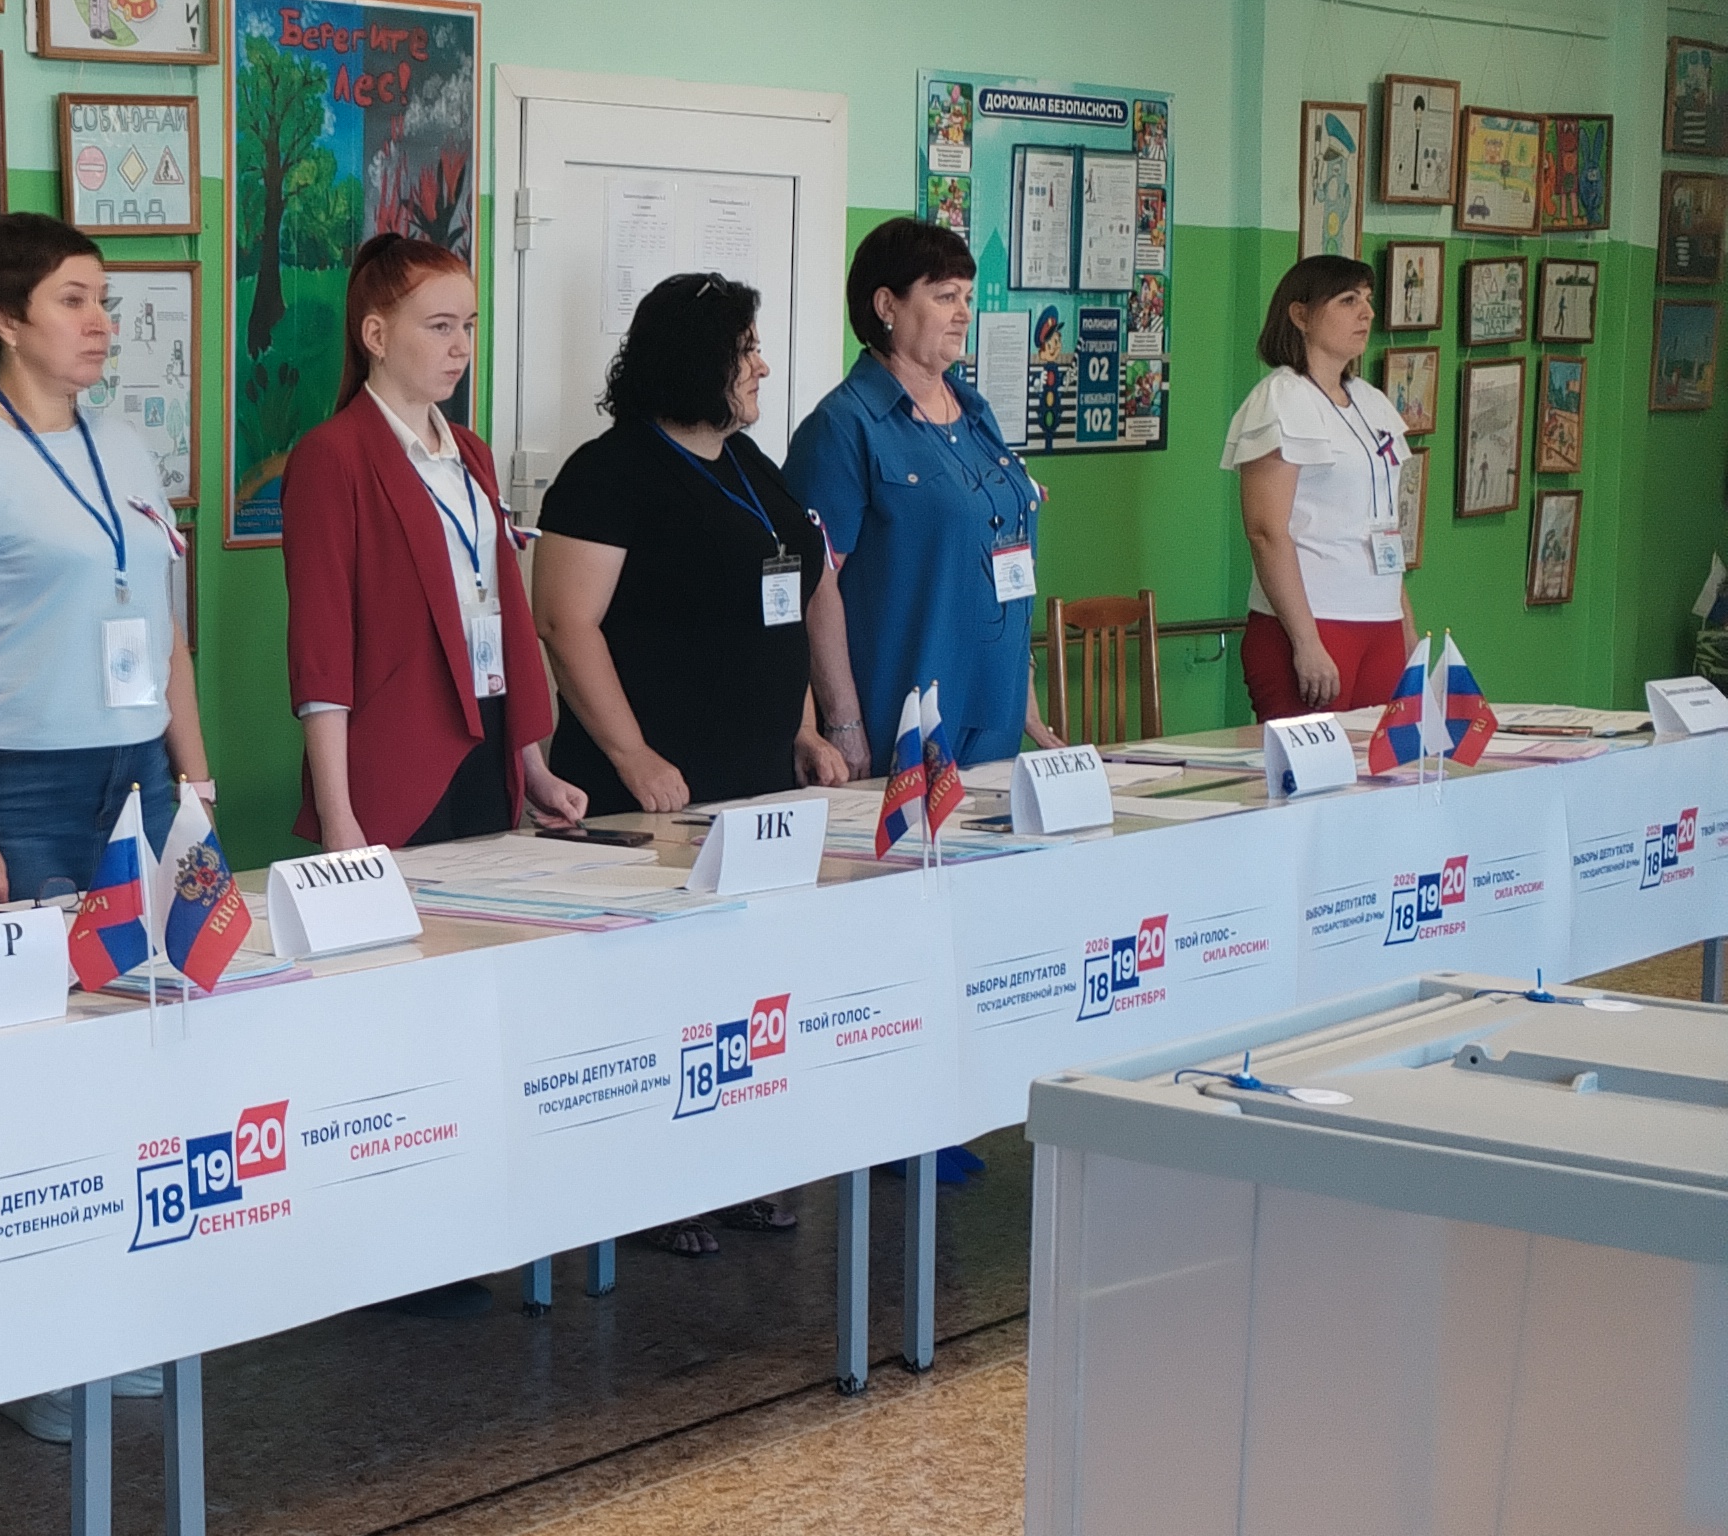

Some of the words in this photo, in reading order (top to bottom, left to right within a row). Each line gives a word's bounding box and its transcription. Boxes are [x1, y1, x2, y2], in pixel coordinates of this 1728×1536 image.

[279, 8, 429, 61] Берегите
[985, 93, 1046, 112] ДОРОЖНАЯ
[1048, 99, 1124, 119] БЕЗОПАСНОСТЬ
[96, 199, 166, 224] ПДД
[1082, 318, 1117, 331] ПОЛИЦИЯ
[1088, 357, 1109, 381] 02
[1083, 407, 1112, 433] 102
[755, 810, 794, 840] ИК
[1648, 852, 1659, 876] 18
[1662, 833, 1676, 859] 19
[1679, 818, 1694, 842] 20
[291, 855, 384, 889] ЛМНО
[1396, 904, 1413, 931] 18
[1419, 884, 1440, 912] 19
[1443, 866, 1466, 895] 20
[1086, 937, 1109, 954] 2026
[1175, 932, 1198, 950] ТВОЙ
[1201, 928, 1229, 944] ГОЛОС
[1203, 948, 1227, 963] СИЛА
[1229, 940, 1268, 957] РОССИИ!
[966, 976, 1007, 996] ВЫБОРЫ
[1010, 963, 1066, 988] ДЕПУТАТОВ
[1089, 973, 1108, 1004] 18
[1114, 947, 1137, 981] 19
[1138, 927, 1165, 961] 20
[977, 985, 1052, 1013] ГОСУДАРСТВЕННОЙ
[1054, 983, 1076, 996] ДУМЫ
[1115, 989, 1165, 1011] СЕНТЯБРЯ
[682, 1023, 712, 1042] 2026
[799, 1012, 828, 1033] ТВОЙ
[832, 1007, 870, 1026] ГОЛОС
[836, 1029, 868, 1046] СИЛА
[872, 1018, 922, 1039] РОССИИ!
[687, 1063, 712, 1098] 18
[719, 1034, 746, 1072] 19
[752, 1009, 787, 1047] 20
[524, 1071, 578, 1096] ВЫБОРЫ
[582, 1054, 656, 1084] ДЕПУТАТОВ
[539, 1079, 638, 1114] ГОСУДАРСТВЕННОЙ
[641, 1075, 670, 1092] ДУМЫ
[722, 1078, 787, 1106] СЕНТЯБРЯ
[301, 1124, 339, 1146] ТВОЙ
[344, 1113, 392, 1136] ГОЛОС
[351, 1139, 390, 1160] СИЛА
[395, 1123, 457, 1150] РОССИИ!
[139, 1137, 180, 1160] 2026
[146, 1184, 184, 1227] 18
[191, 1148, 233, 1194] 19
[239, 1119, 282, 1165] 20
[1, 1176, 103, 1215] ДЕПУТАТОВ
[83, 1199, 123, 1222] ДУМЫ
[199, 1199, 290, 1235] СЕНТЯБРЯ
